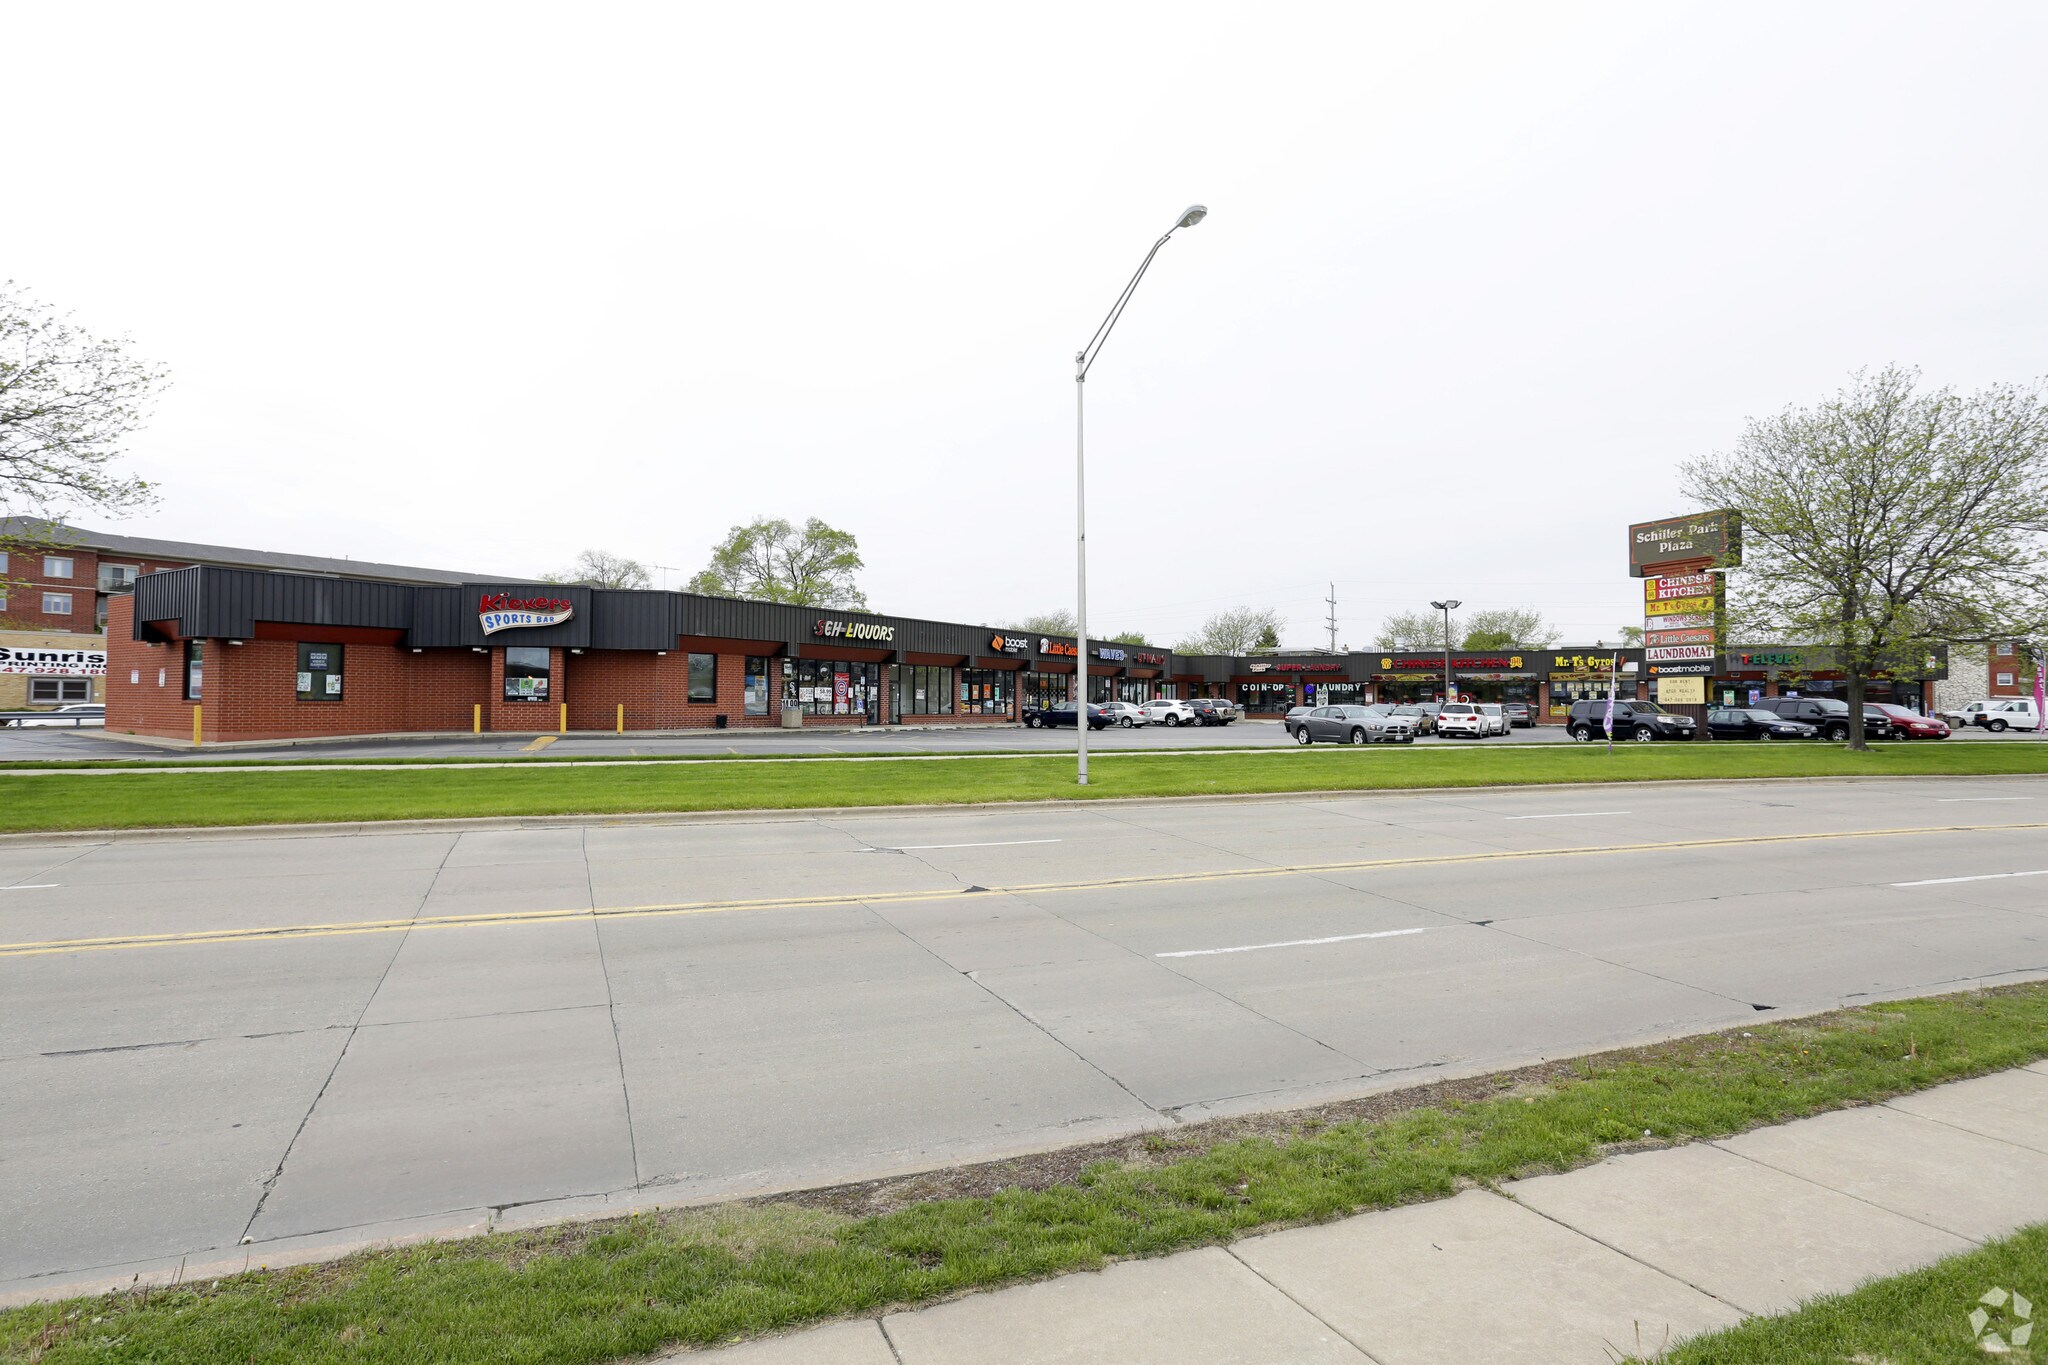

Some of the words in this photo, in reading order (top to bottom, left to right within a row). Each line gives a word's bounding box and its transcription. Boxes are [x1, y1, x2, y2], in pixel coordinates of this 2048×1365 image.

[1636, 528, 1682, 543] Schiller
[1689, 521, 1719, 536] Park
[1659, 541, 1693, 553] Plaza
[1659, 574, 1712, 588] CHINESE
[1658, 584, 1712, 599] KITCHEN
[479, 592, 571, 613] Kickers
[485, 613, 531, 629] SPORTS
[846, 622, 895, 641] LIQUORS
[1660, 634, 1680, 644] Little
[1680, 633, 1710, 643] Caesars
[1005, 636, 1028, 648] boost
[1049, 641, 1064, 655] Little
[1647, 646, 1712, 660] LAUNDROMAT
[1393, 659, 1446, 669] CHINESE
[1451, 657, 1509, 668] KITCHEN
[1555, 656, 1570, 667] Mr.
[1572, 655, 1584, 667] T's
[1587, 656, 1614, 669] Gyros
[1316, 683, 1361, 692] LAUNDRY
